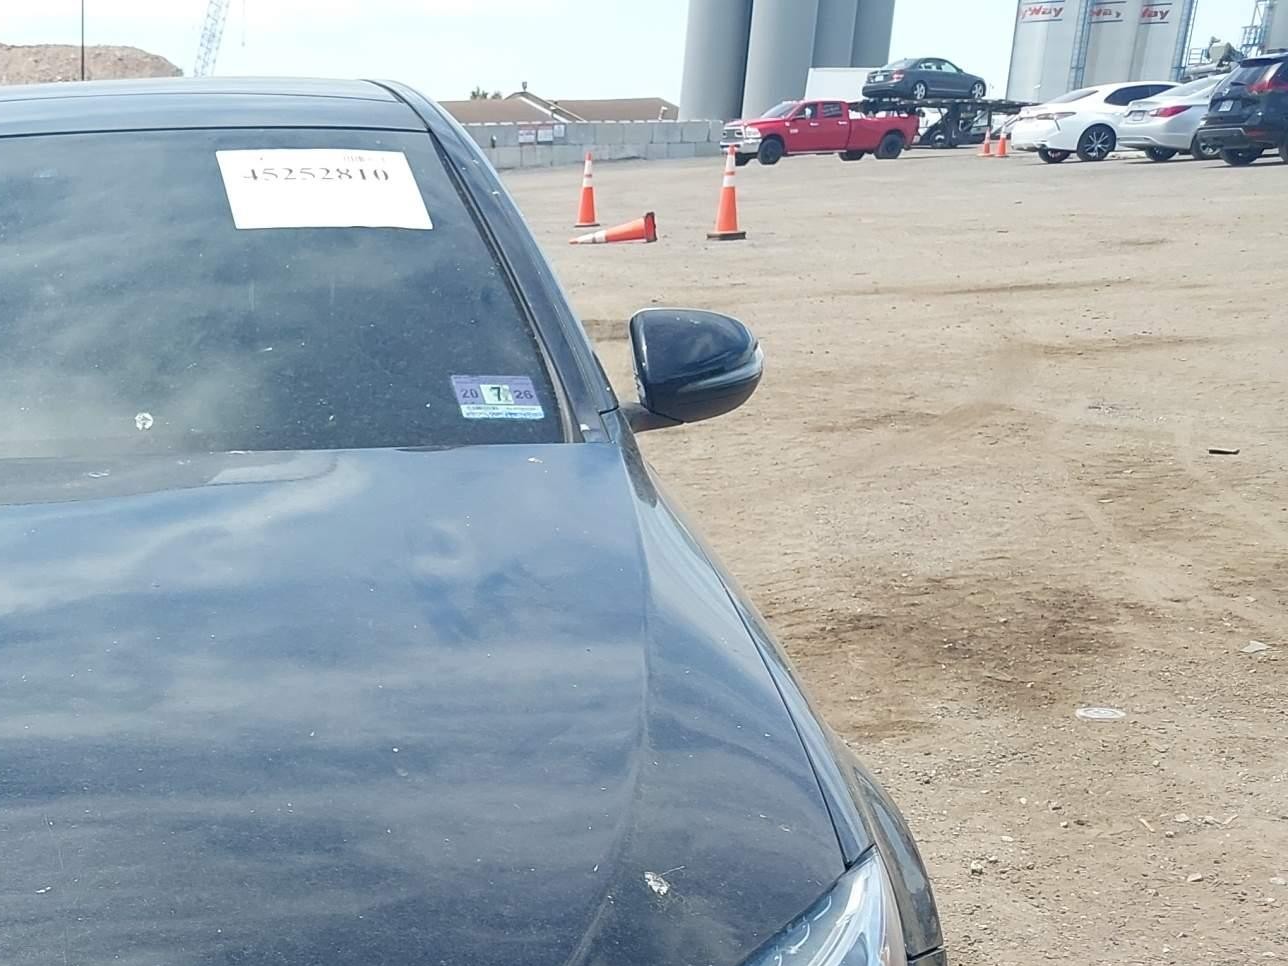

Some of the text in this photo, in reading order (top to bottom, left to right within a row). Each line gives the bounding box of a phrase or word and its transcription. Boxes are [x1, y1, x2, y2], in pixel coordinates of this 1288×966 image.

[243, 167, 390, 182] 45252810
[460, 386, 534, 402] 20 7 26
